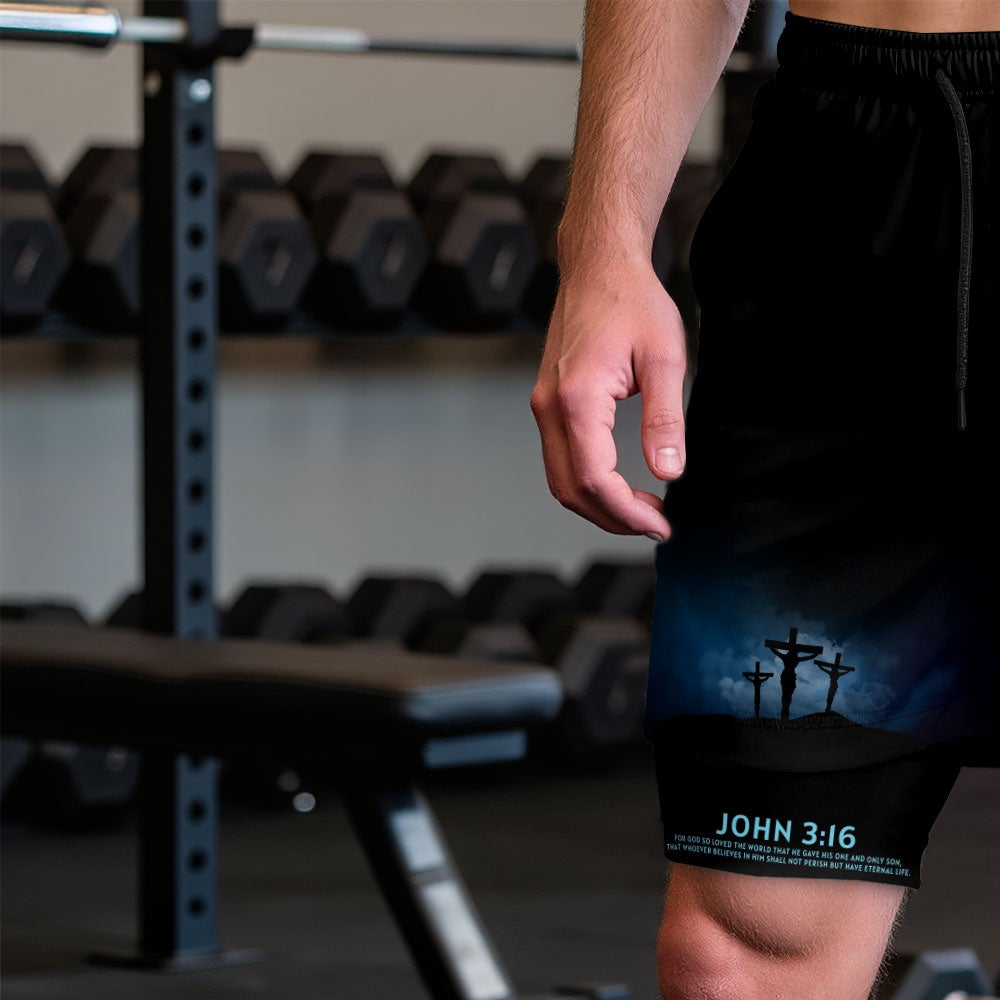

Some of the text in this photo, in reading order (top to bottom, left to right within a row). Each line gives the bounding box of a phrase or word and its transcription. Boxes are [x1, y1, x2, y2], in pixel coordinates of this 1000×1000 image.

[715, 812, 856, 849] JOHN 3:16
[674, 834, 686, 842] FOR
[712, 839, 732, 848] LOVED
[734, 841, 746, 850] THE
[748, 844, 771, 853] WORLD
[773, 846, 790, 855] THAT
[802, 850, 820, 858] GAVE
[821, 851, 833, 859] HIS
[835, 852, 849, 861] ONE
[850, 854, 865, 862] AND
[866, 856, 885, 864] ONLY
[682, 844, 711, 854] WHOEVER
[712, 848, 742, 859] BELIEVES
[751, 853, 765, 862] HIM
[766, 855, 786, 864] SHALL
[788, 858, 802, 866] NOT
[804, 859, 828, 868] PERISH
[845, 863, 863, 872] HAVE
[864, 865, 894, 875] ETERNAL
